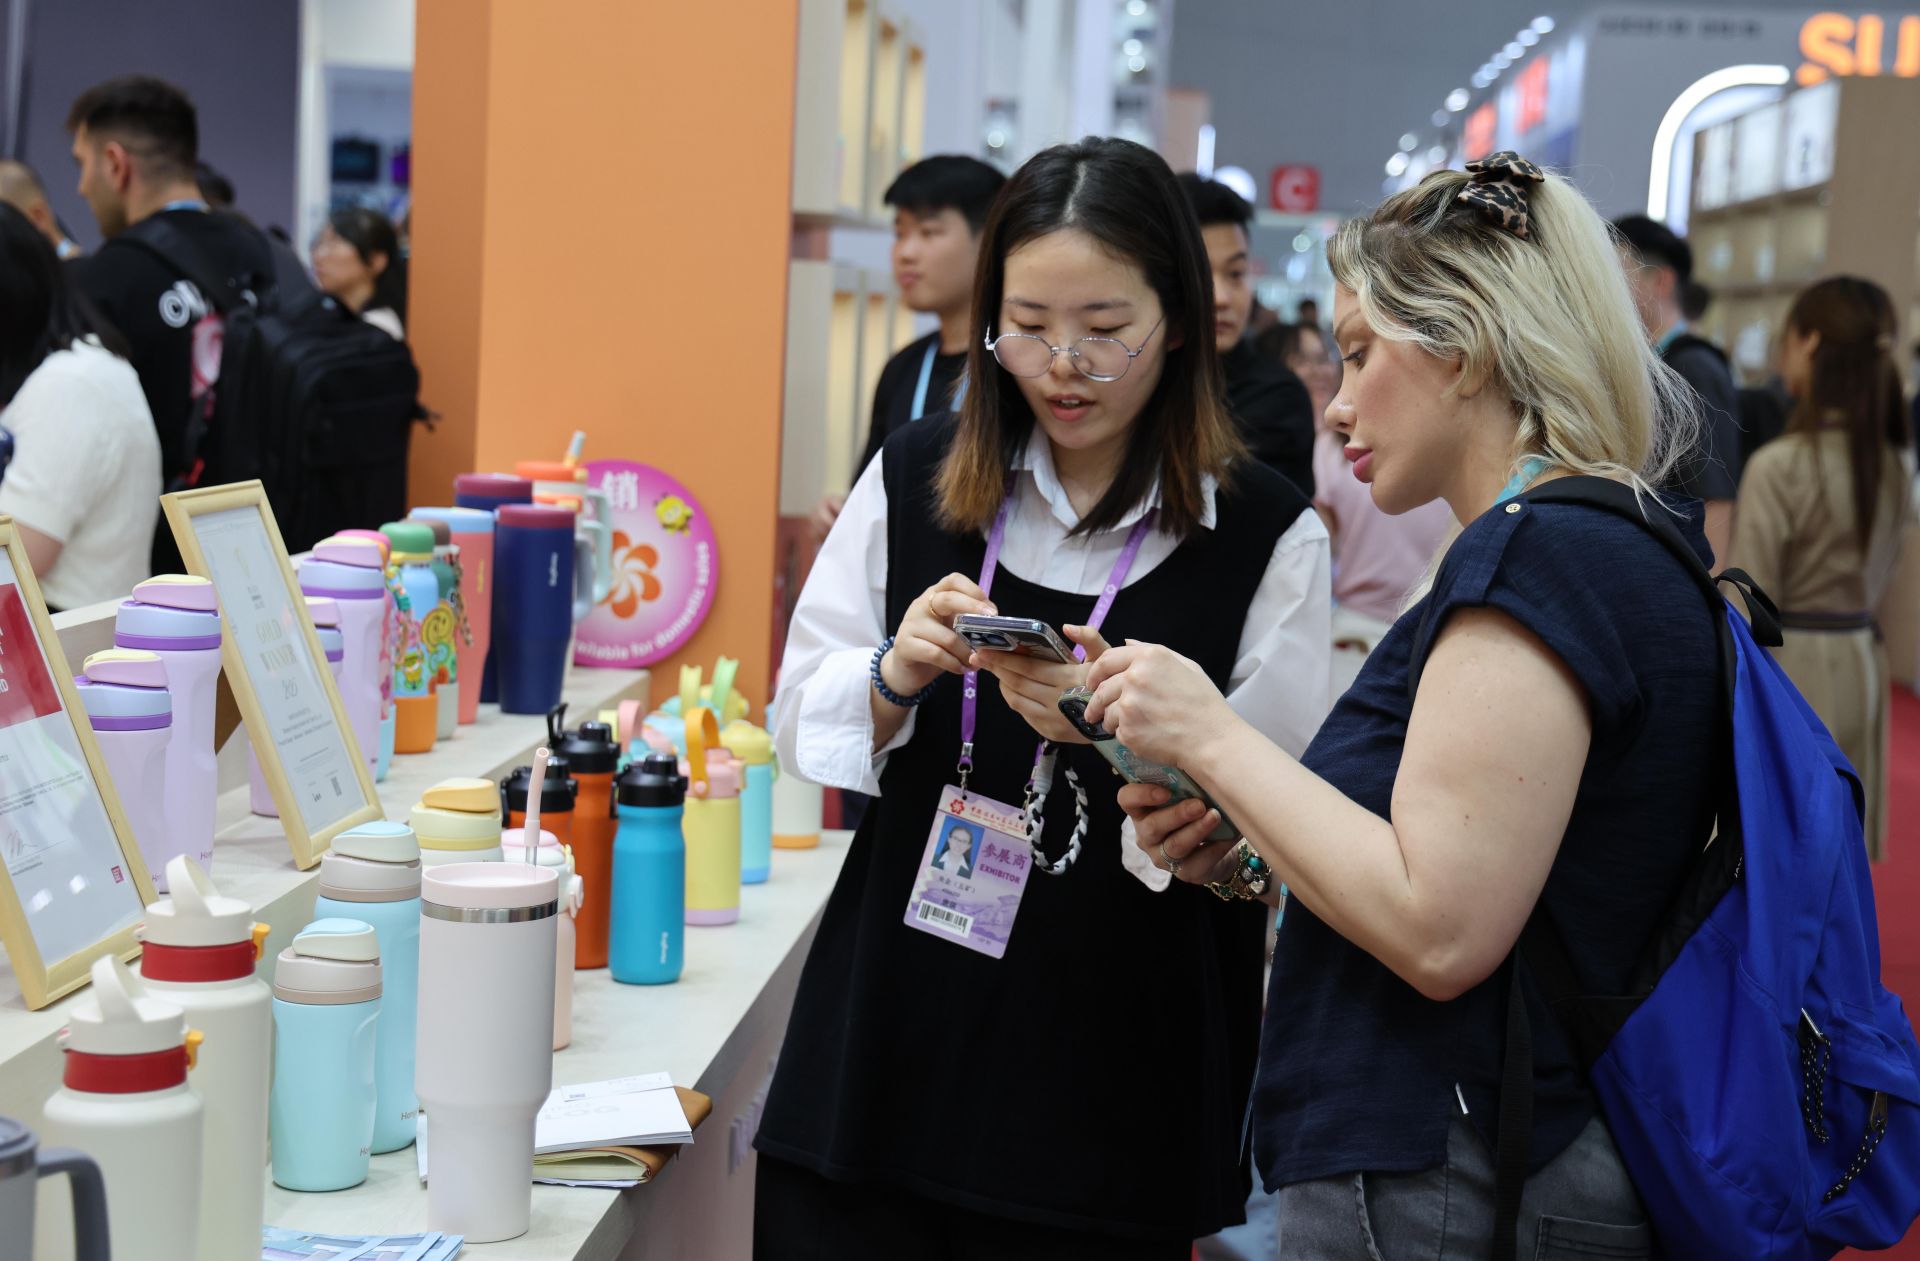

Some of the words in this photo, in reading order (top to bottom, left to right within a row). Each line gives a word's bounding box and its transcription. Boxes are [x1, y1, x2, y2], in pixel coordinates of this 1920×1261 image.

[630, 640, 653, 657] for
[655, 587, 706, 649] domestic
[694, 541, 710, 585] sales
[982, 842, 1028, 870] 参展商
[979, 863, 1021, 885] EXHIBITOR
